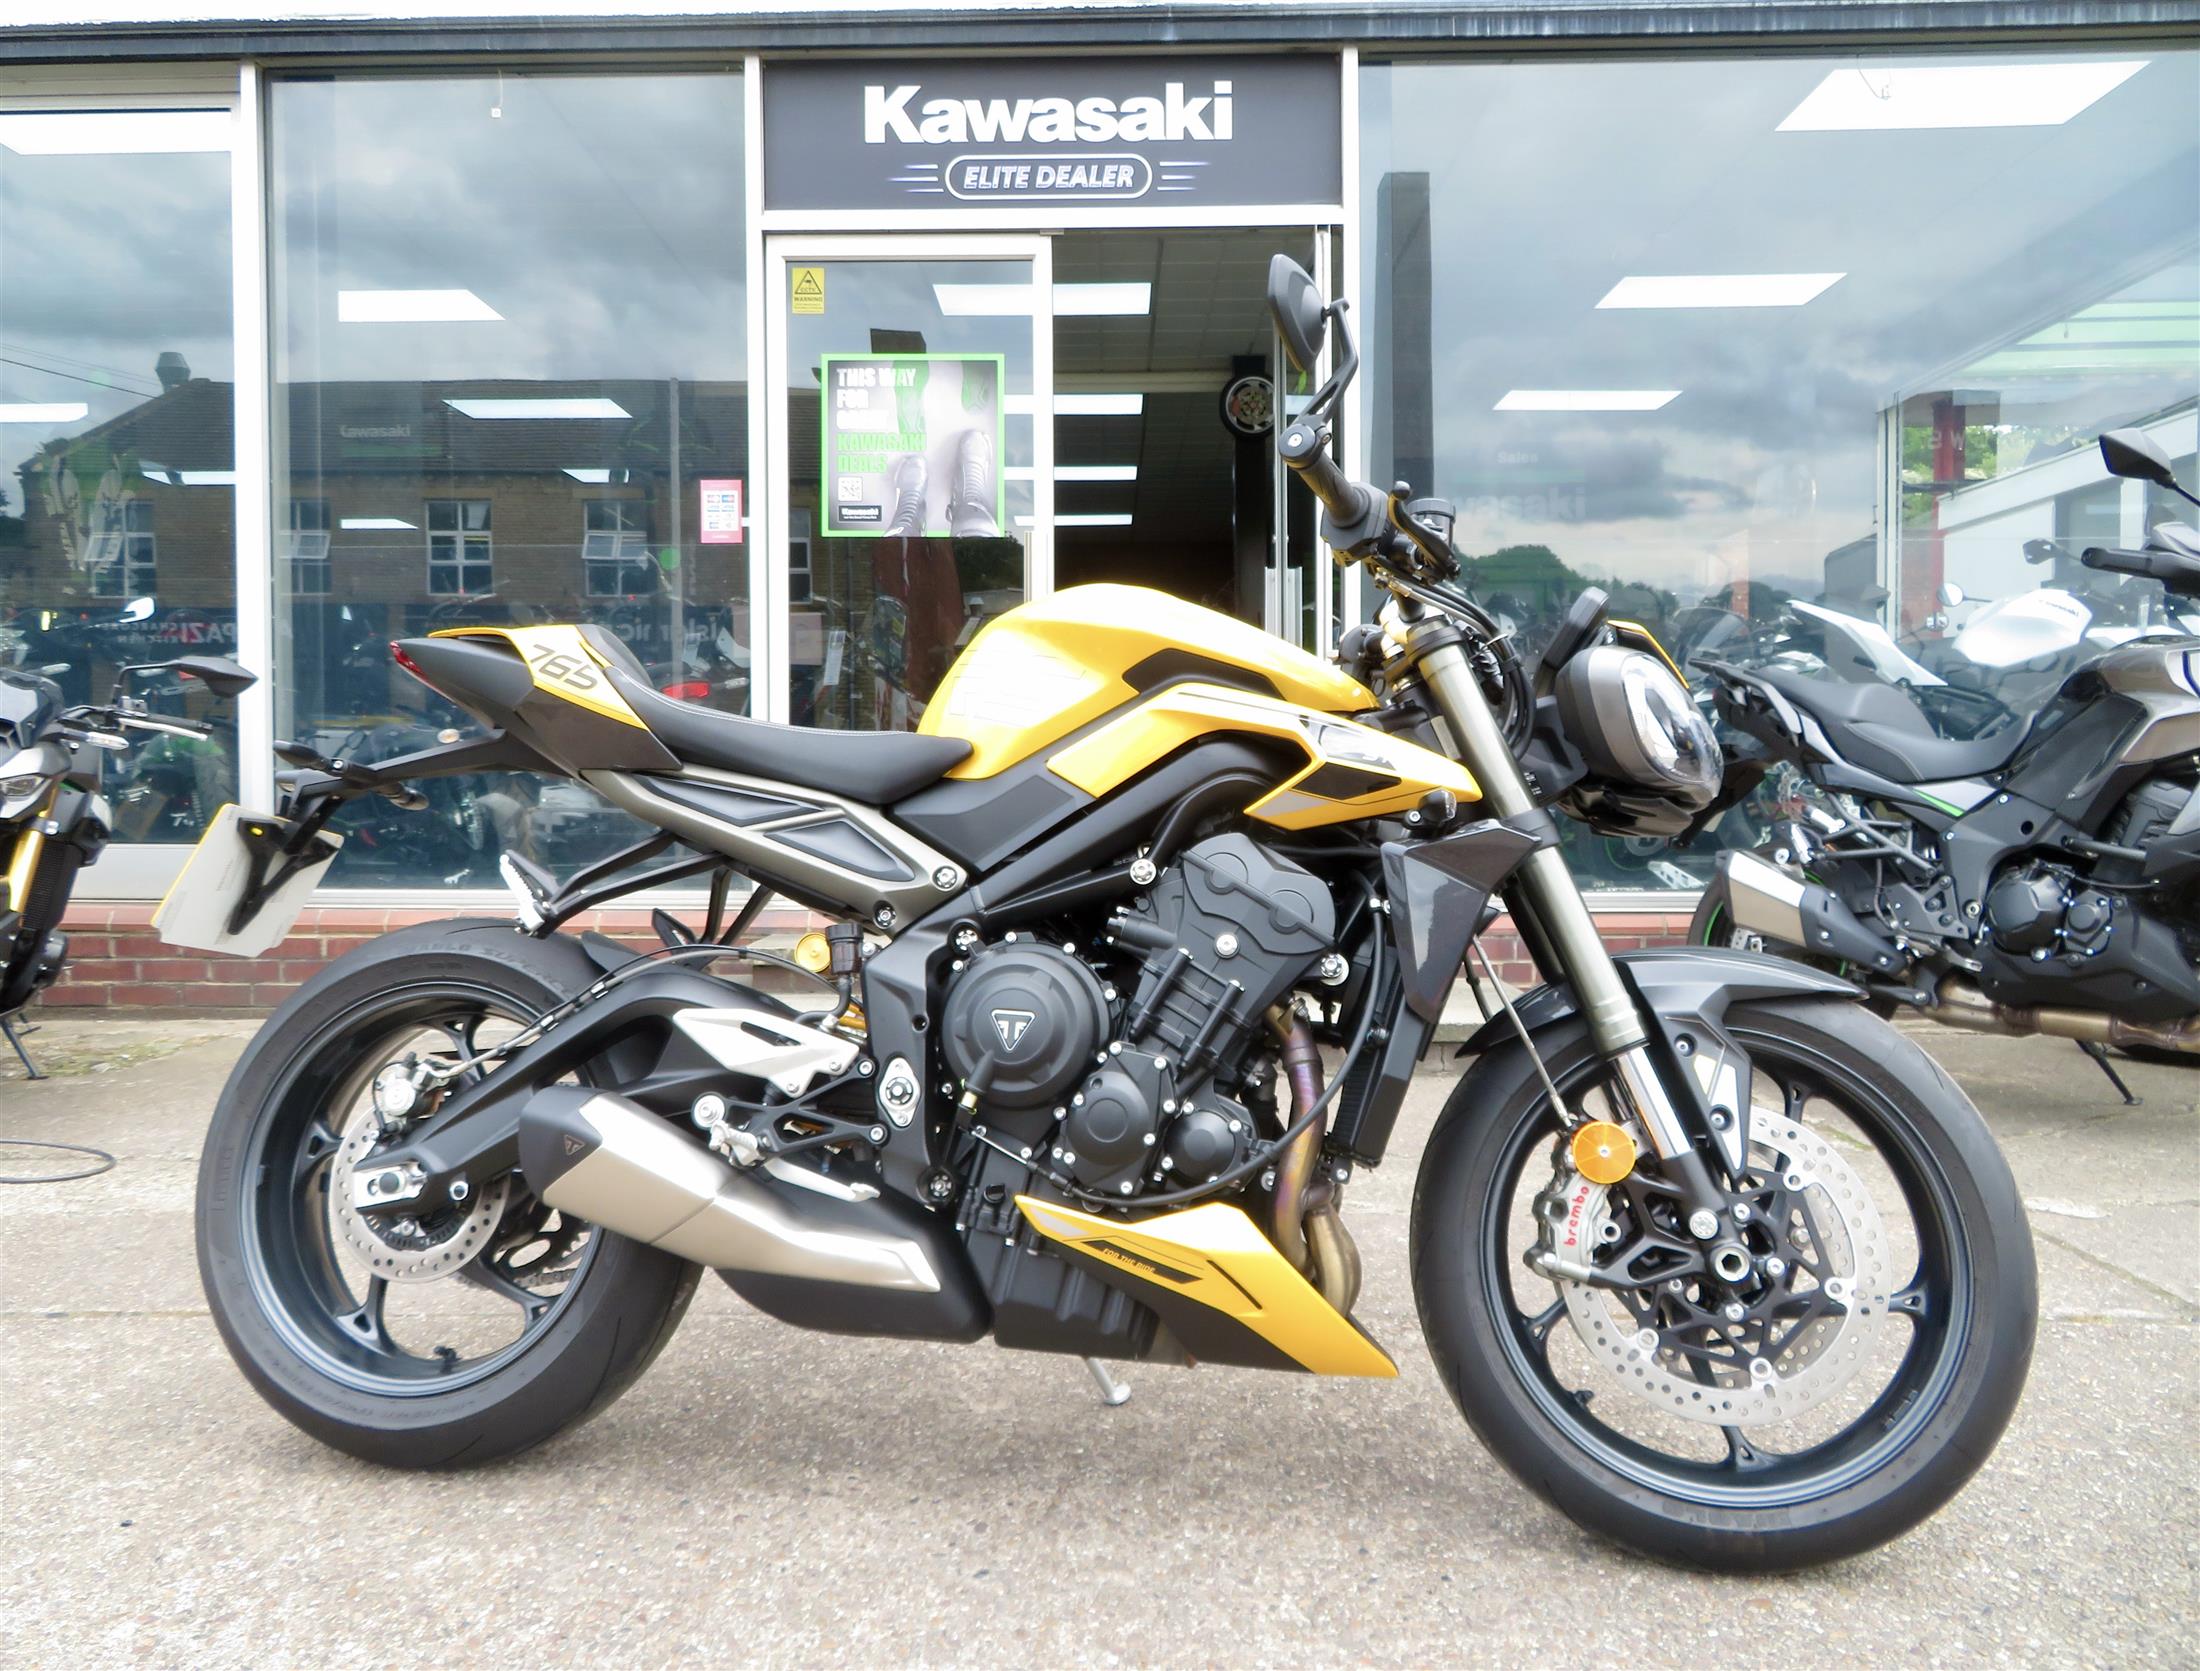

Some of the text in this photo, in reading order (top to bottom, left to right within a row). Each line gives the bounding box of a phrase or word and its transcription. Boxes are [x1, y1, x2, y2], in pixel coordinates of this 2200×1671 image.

[864, 80, 1233, 144] Kawasaki
[963, 164, 1134, 189] ELITE DEALER
[837, 367, 916, 387] THIS WAY
[837, 389, 869, 409] FOR
[837, 432, 928, 451] KAWASAKI
[837, 454, 888, 473] DEALS
[530, 643, 598, 690] 765
[1563, 1186, 1590, 1247] brembo
[1103, 1247, 1156, 1273] FOR THE RIDE
